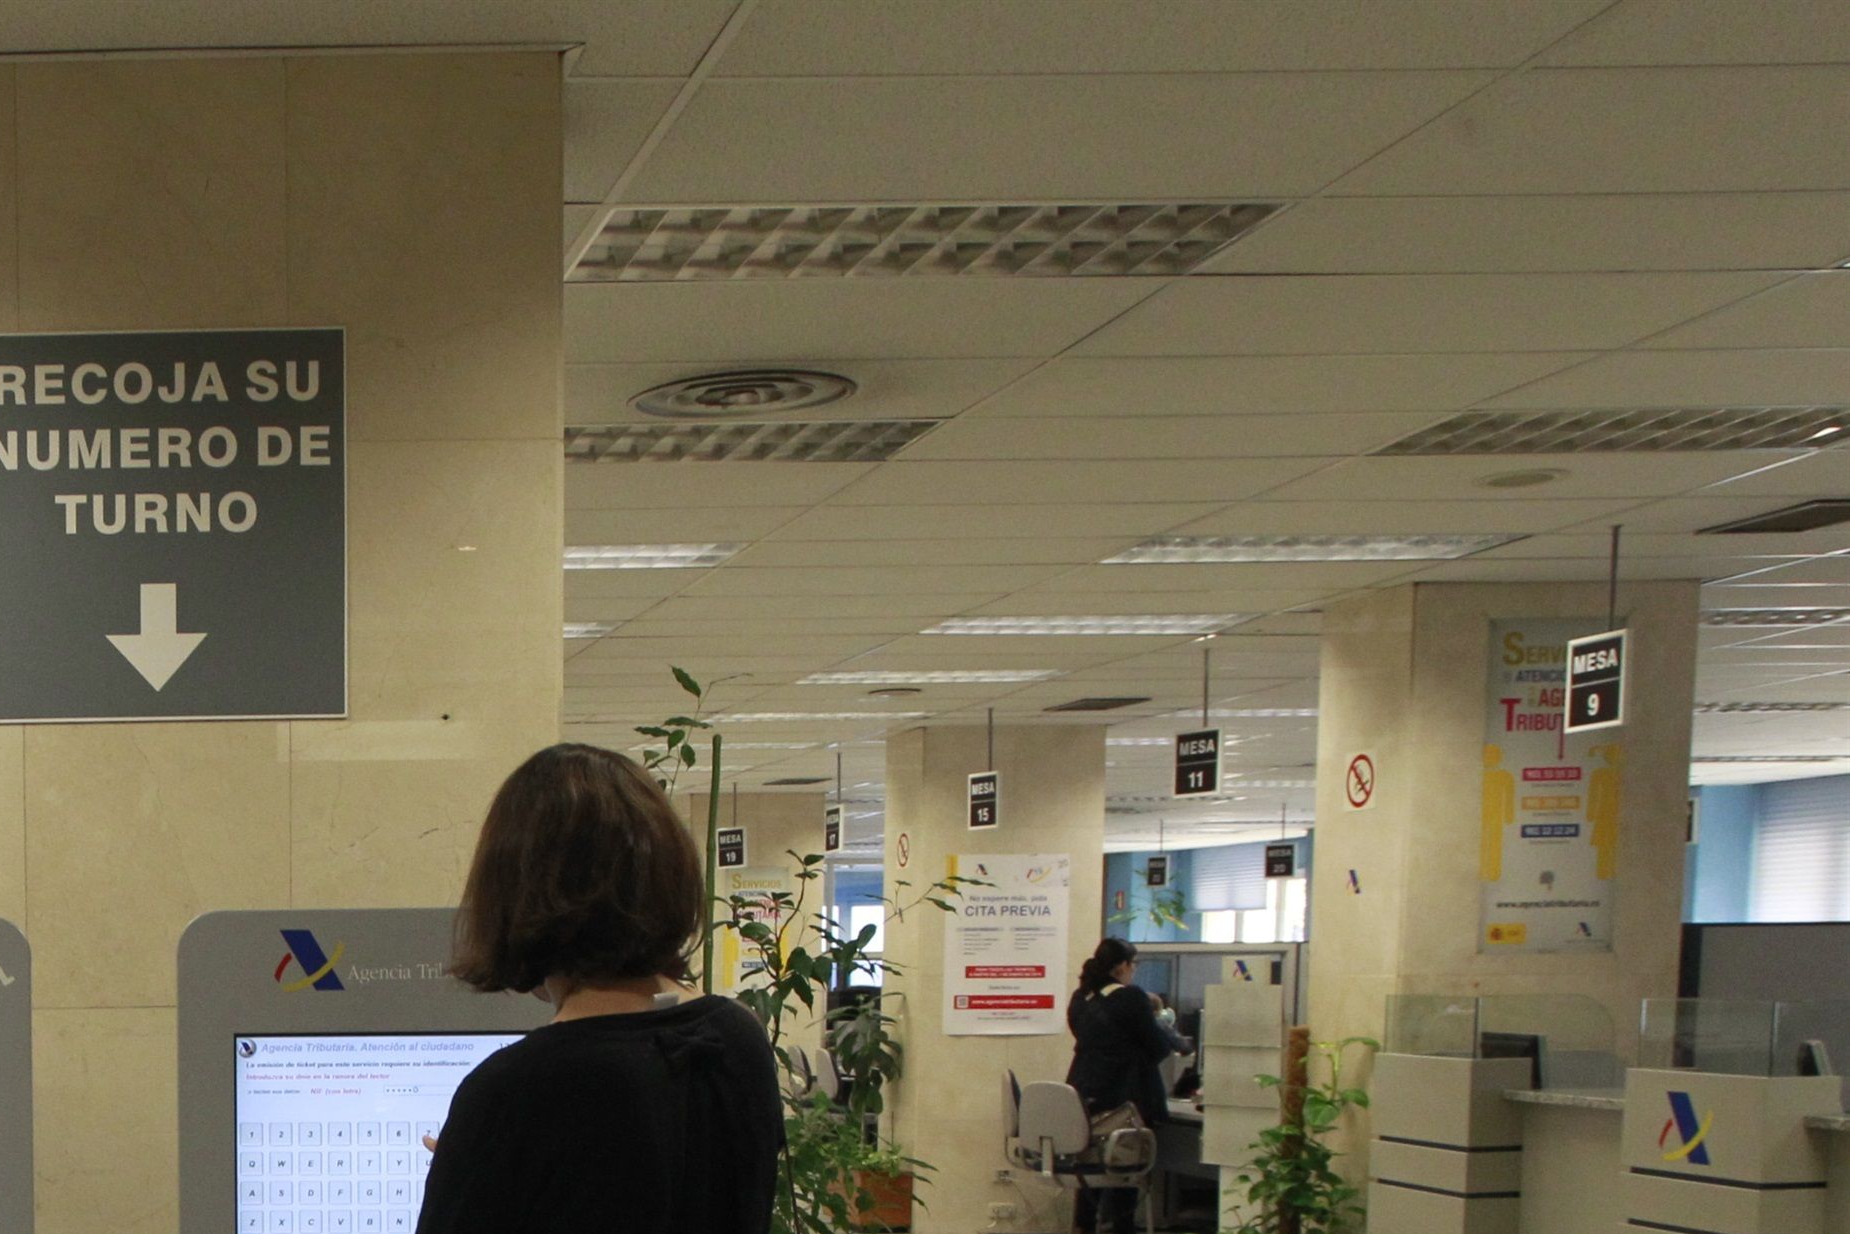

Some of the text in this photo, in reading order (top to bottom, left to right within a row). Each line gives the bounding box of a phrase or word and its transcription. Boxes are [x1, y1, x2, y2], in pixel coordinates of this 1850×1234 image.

[245, 359, 321, 402] SU
[256, 425, 331, 467] DE
[54, 490, 259, 535] TURNO
[1573, 647, 1619, 675] MESA
[1587, 693, 1600, 717] 9
[1179, 739, 1215, 756] MESA
[1188, 771, 1204, 788] 11
[971, 781, 995, 796] MESA
[977, 807, 989, 822] 15
[719, 833, 742, 845] MESA
[726, 851, 737, 863] 19
[965, 905, 1052, 917] CITA PREVIA
[349, 963, 411, 984] Agencia
[261, 1043, 303, 1054] Agencia
[360, 1041, 406, 1052] Atención
[409, 1042, 419, 1051] al
[421, 1042, 475, 1052] ciudadano
[308, 1130, 313, 1138] 3
[337, 1130, 343, 1138] 4
[277, 1160, 286, 1168] W
[367, 1159, 372, 1167] T
[248, 1189, 256, 1197] A
[278, 1189, 284, 1197] S
[307, 1189, 314, 1197] D
[337, 1218, 344, 1226] V
[367, 1218, 373, 1226] B
